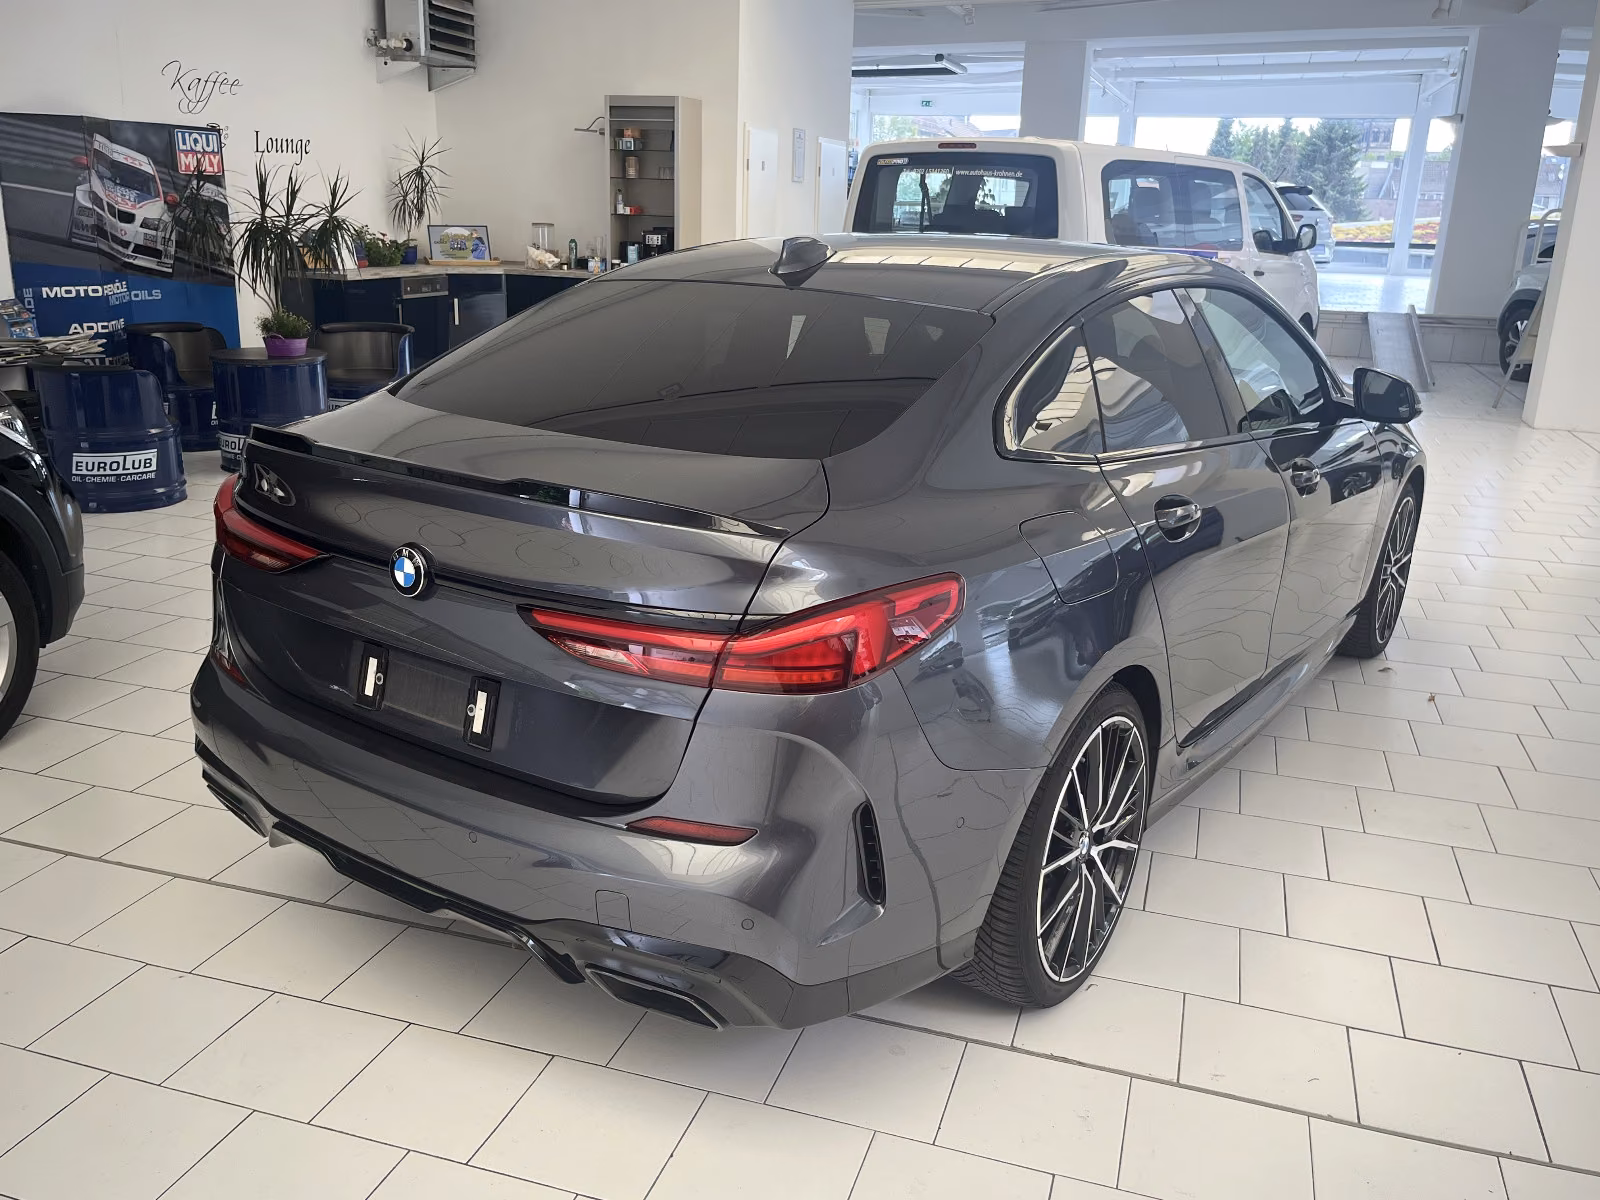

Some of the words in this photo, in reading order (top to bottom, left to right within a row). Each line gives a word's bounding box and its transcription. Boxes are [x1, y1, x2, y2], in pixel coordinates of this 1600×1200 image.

[161, 60, 243, 114] Kaffee
[177, 132, 218, 153] LIQUI
[254, 130, 311, 166] Lounge
[956, 169, 1023, 178] www.autohaus-krohnen.de
[131, 290, 162, 301] OILS
[75, 455, 153, 472] EUROLUB
